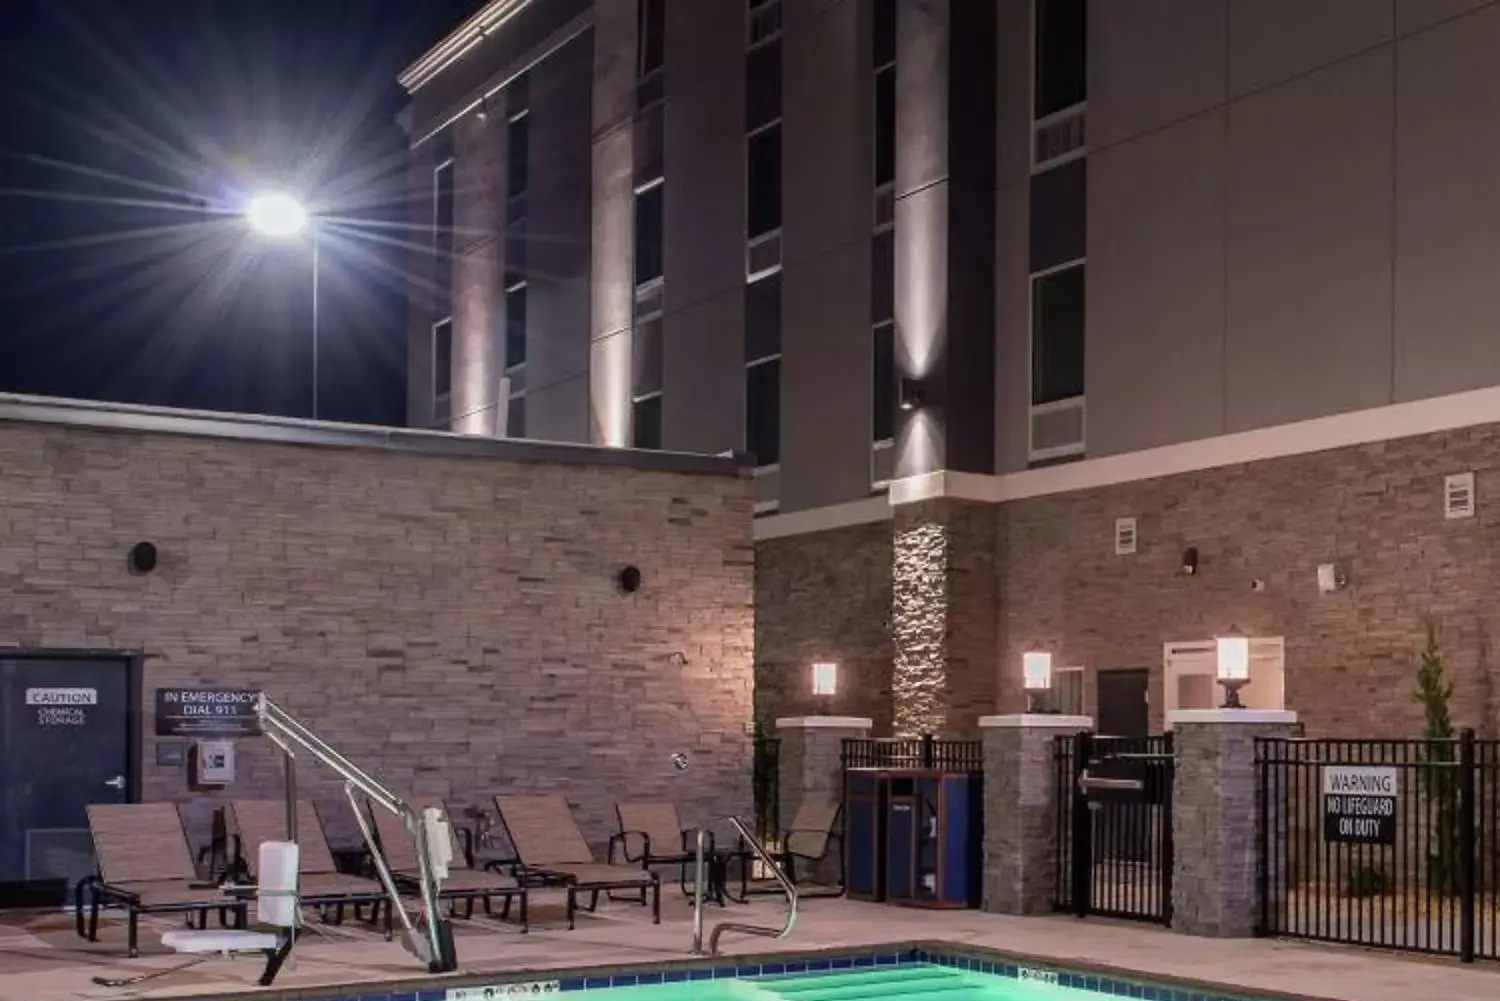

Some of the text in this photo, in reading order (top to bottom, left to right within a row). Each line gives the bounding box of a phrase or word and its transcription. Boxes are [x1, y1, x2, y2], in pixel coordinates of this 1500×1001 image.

[32, 692, 92, 703] CAUTION
[164, 691, 255, 703] IN EMERGENCY
[183, 704, 237, 715] DIAL 911
[37, 715, 85, 725] STORAGE
[1331, 773, 1391, 793] WARNING
[1327, 797, 1393, 816] NO LIFEGUARD
[1339, 816, 1381, 837] ON DUTY
